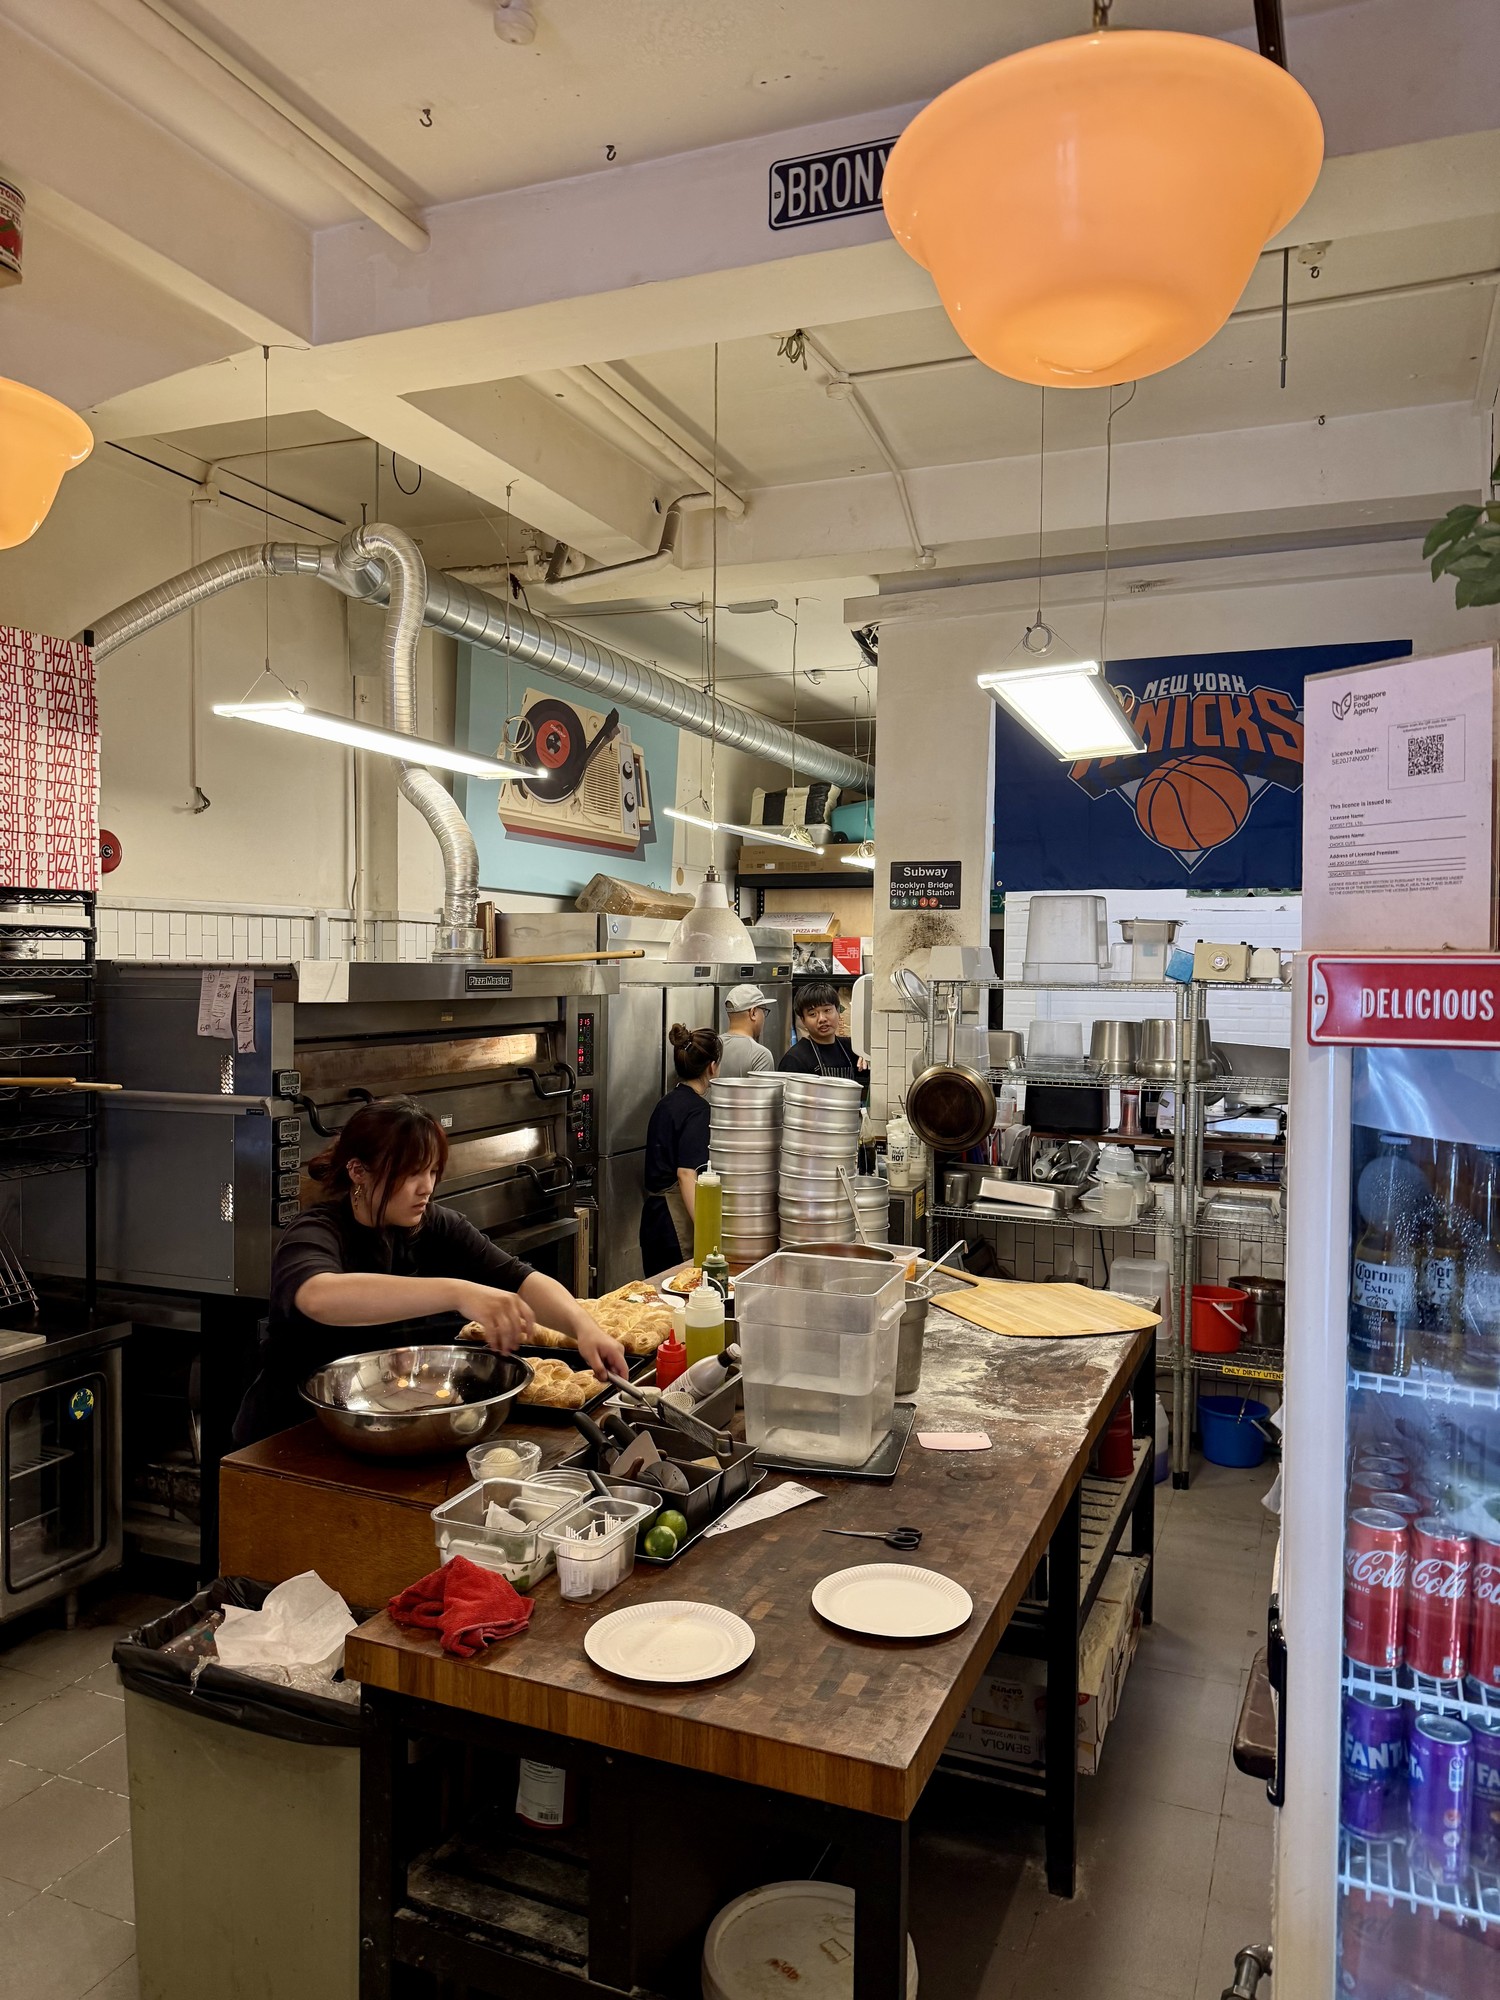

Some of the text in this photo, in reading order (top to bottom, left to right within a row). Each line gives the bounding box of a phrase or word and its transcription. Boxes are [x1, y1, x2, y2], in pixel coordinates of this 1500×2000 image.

[42, 634, 74, 660] PIZZA
[76, 642, 93, 664] PIE
[45, 653, 76, 677] PIZZA
[80, 661, 96, 681] PIE
[43, 672, 75, 695] PIZZA
[79, 679, 96, 699] PIE
[1143, 672, 1247, 700] NEW YORK
[1353, 690, 1387, 702] Singapore
[46, 690, 78, 714] PIZZA
[82, 698, 98, 717] PIE
[1353, 700, 1370, 709] Food
[1353, 706, 1379, 717] Agency
[48, 709, 79, 732] PIZZA
[83, 716, 99, 736] PIE
[47, 727, 77, 750] PIZZA
[82, 733, 97, 754] PIE
[46, 745, 76, 768] PIZZA
[81, 750, 96, 771] PIE
[1331, 749, 1354, 758] Licence
[47, 763, 77, 785] PIZZA
[81, 768, 97, 788] PIE
[46, 781, 76, 803] PIZZA
[81, 786, 96, 804] PIE
[1366, 799, 1385, 807] issued
[45, 799, 74, 820] PIZZA
[79, 803, 94, 823] PIE
[46, 817, 76, 838] PIZZA
[81, 820, 96, 839] PIE
[46, 834, 76, 855] PIZZA
[80, 838, 96, 856] PIE
[47, 853, 78, 873] PIZZA
[83, 856, 98, 875] PIE
[903, 866, 948, 878] Subway
[48, 871, 79, 891] PIZZA
[83, 873, 99, 892] PIE
[890, 881, 954, 890] Brooklyn Bridge
[890, 889, 906, 897] City
[469, 975, 511, 986] PizzaMaster
[1361, 987, 1495, 1022] DELICIOUS
[891, 1154, 904, 1162] HOT
[1364, 1280, 1394, 1295] Extra
[1224, 1367, 1240, 1375] ONLY
[1242, 1369, 1262, 1377] DIRTY
[1353, 1549, 1408, 1589] Cola
[1411, 1558, 1471, 1599] Cola
[980, 1737, 1032, 1755] SEMOLA
[1344, 1730, 1408, 1770] FANT
